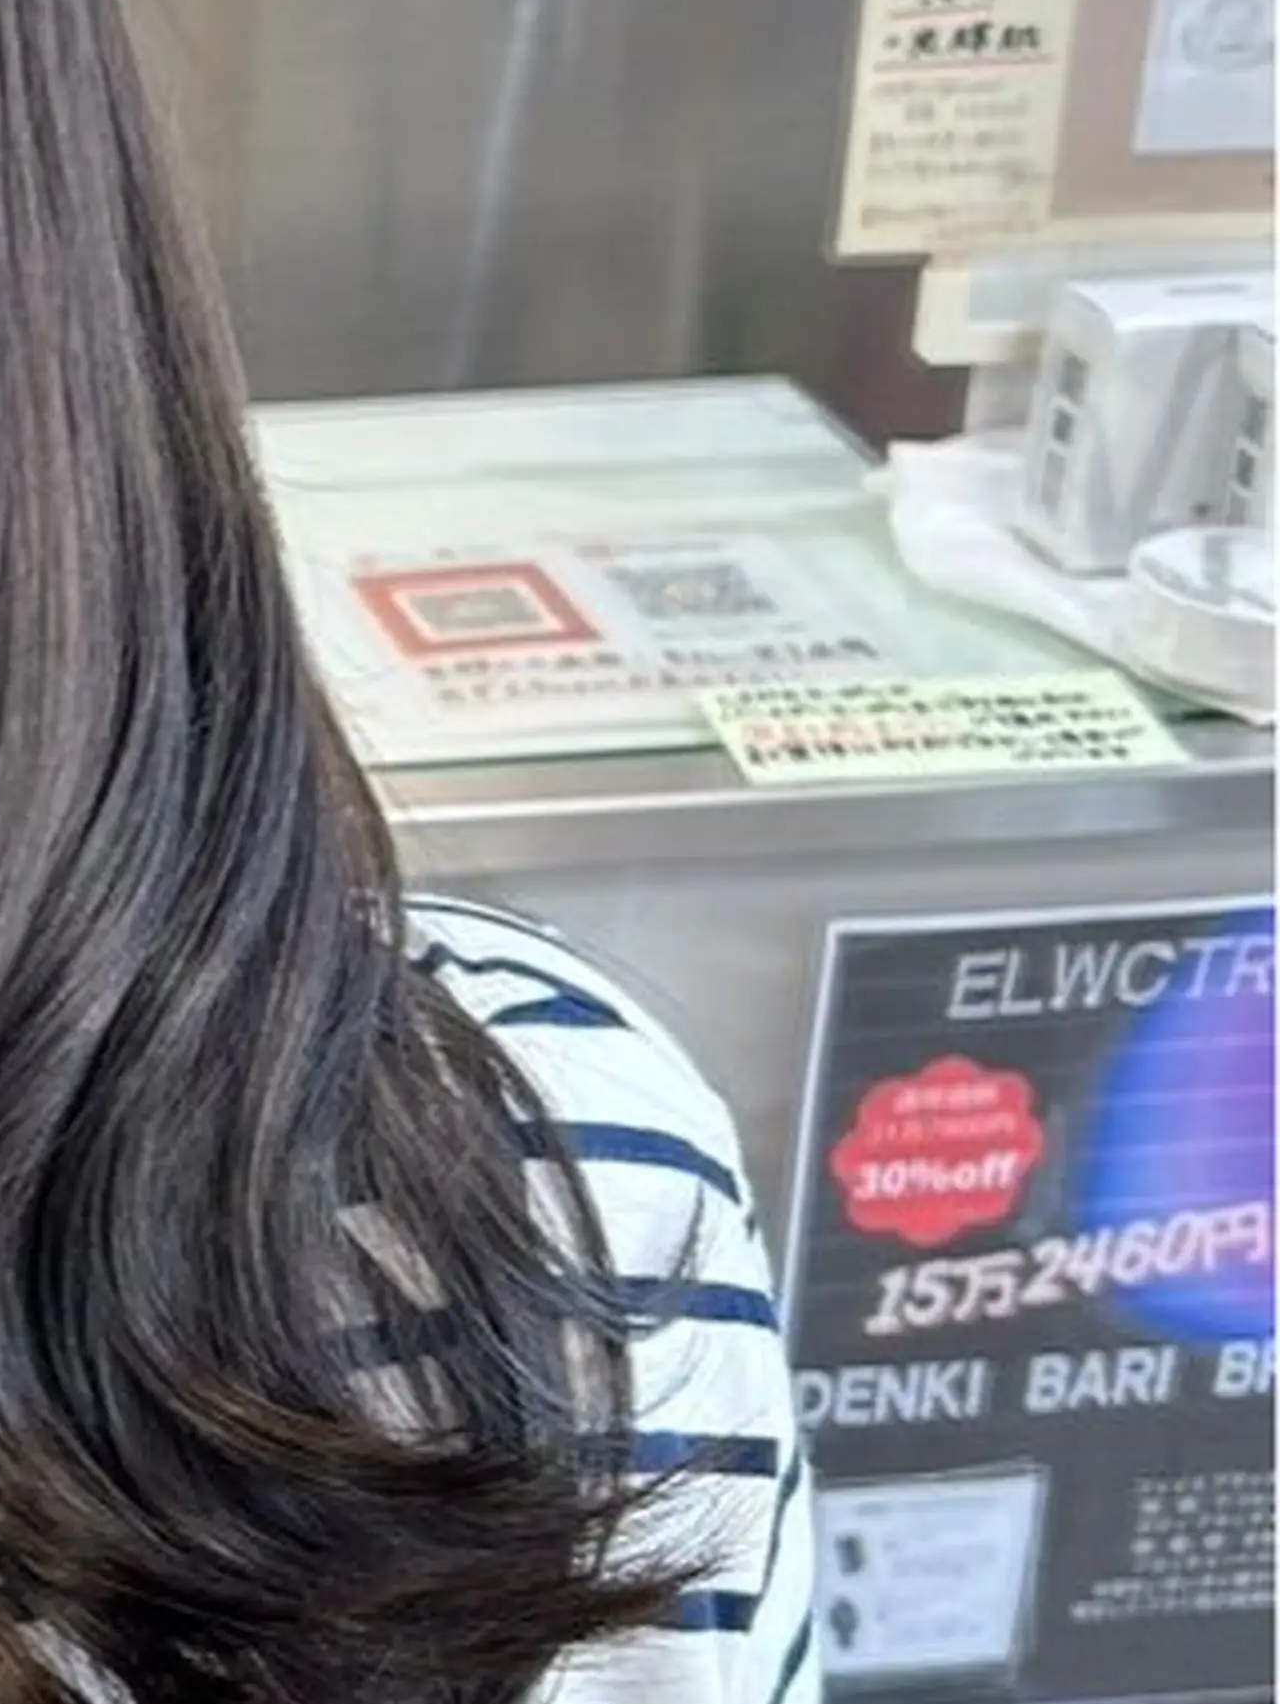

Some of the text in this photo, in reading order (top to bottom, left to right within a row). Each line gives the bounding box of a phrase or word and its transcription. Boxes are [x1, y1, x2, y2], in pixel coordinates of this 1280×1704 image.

[853, 1150, 1018, 1202] 30%off
[862, 1200, 1272, 1336] 15万2460円
[792, 1358, 988, 1427] DENKI
[1024, 1345, 1179, 1413] BARI
